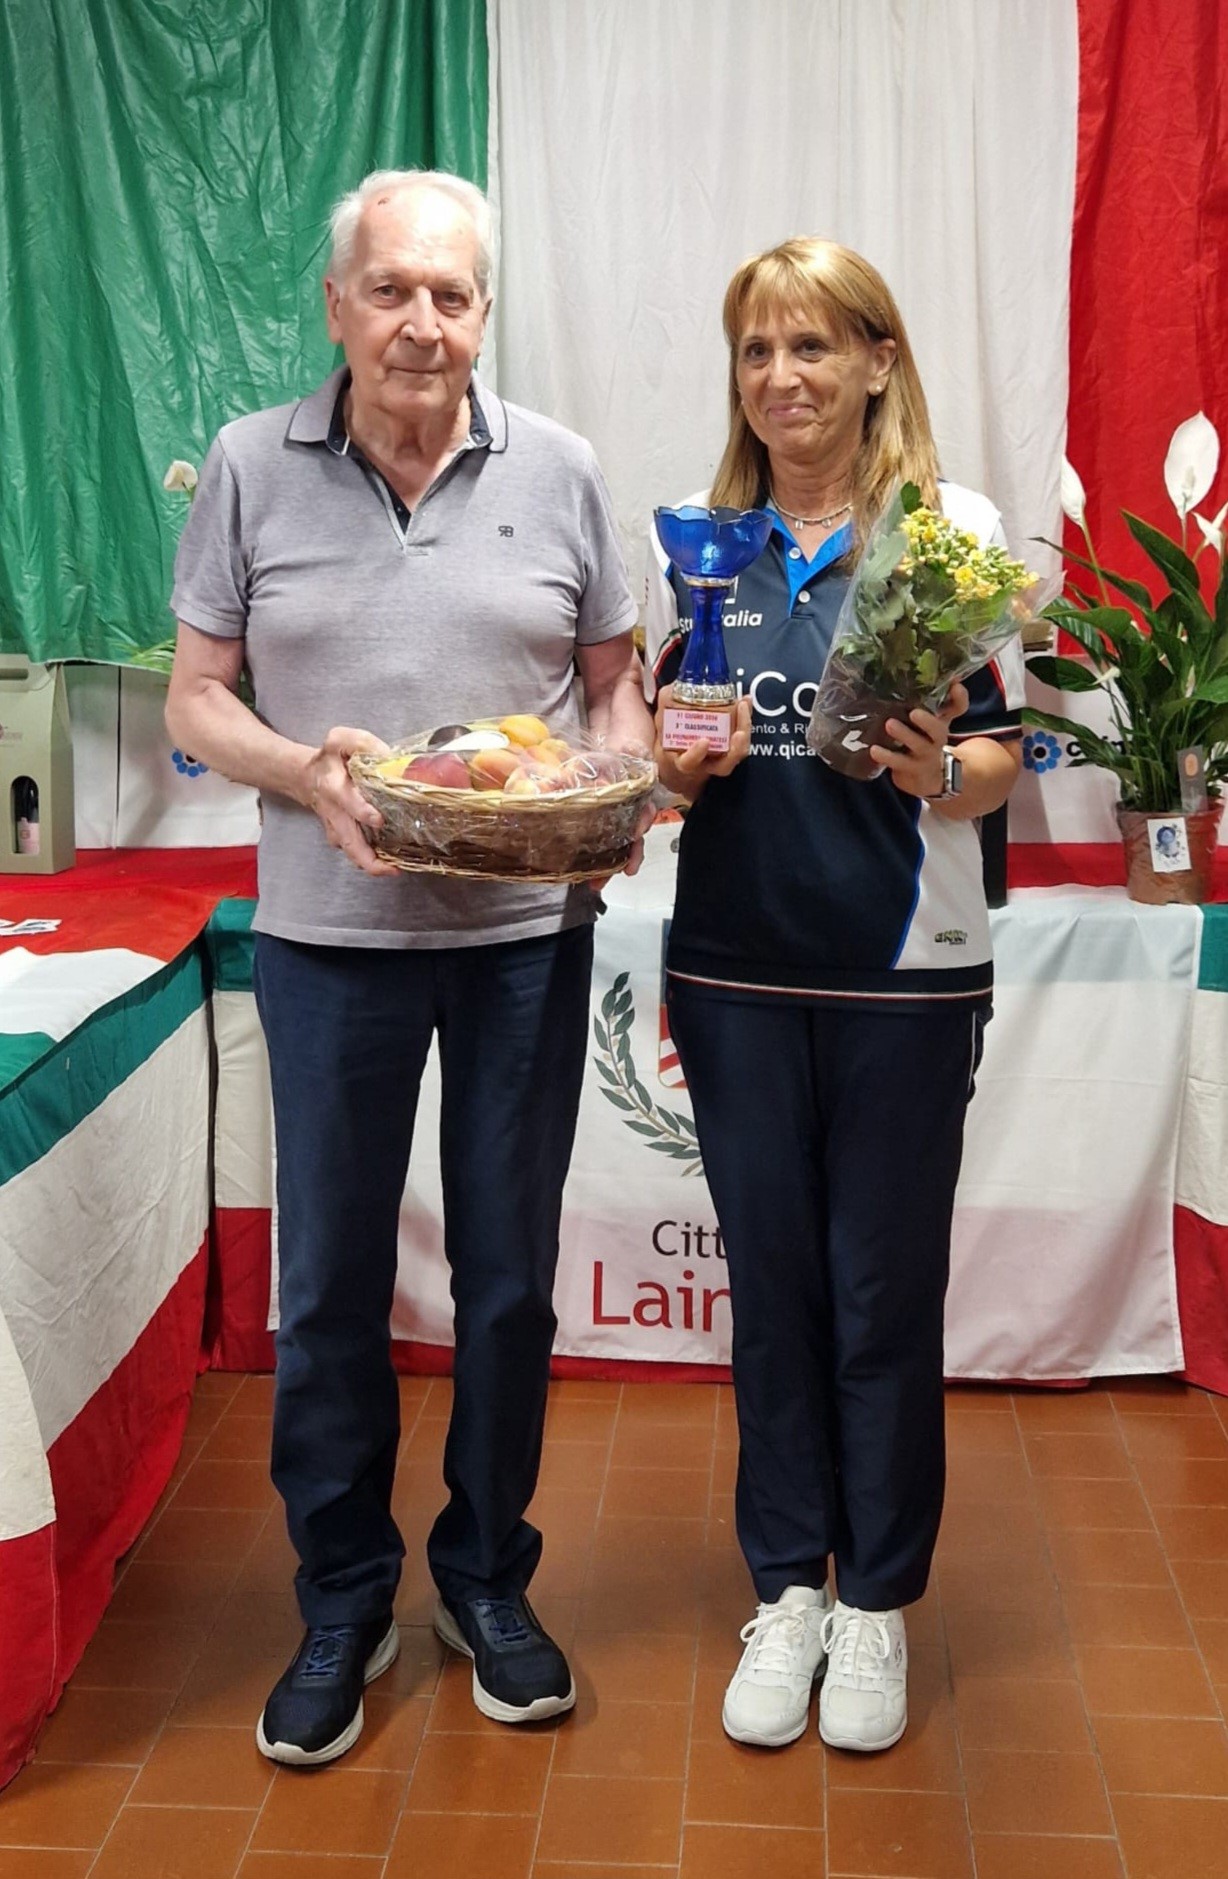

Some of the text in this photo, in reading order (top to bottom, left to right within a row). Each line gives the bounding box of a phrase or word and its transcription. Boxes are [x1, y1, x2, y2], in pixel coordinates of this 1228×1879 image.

[684, 723, 718, 731] CLASSIFICATA
[751, 723, 777, 734] ento
[780, 722, 790, 734] &
[652, 1220, 727, 1259] Citt
[593, 1260, 732, 1333] Lain
